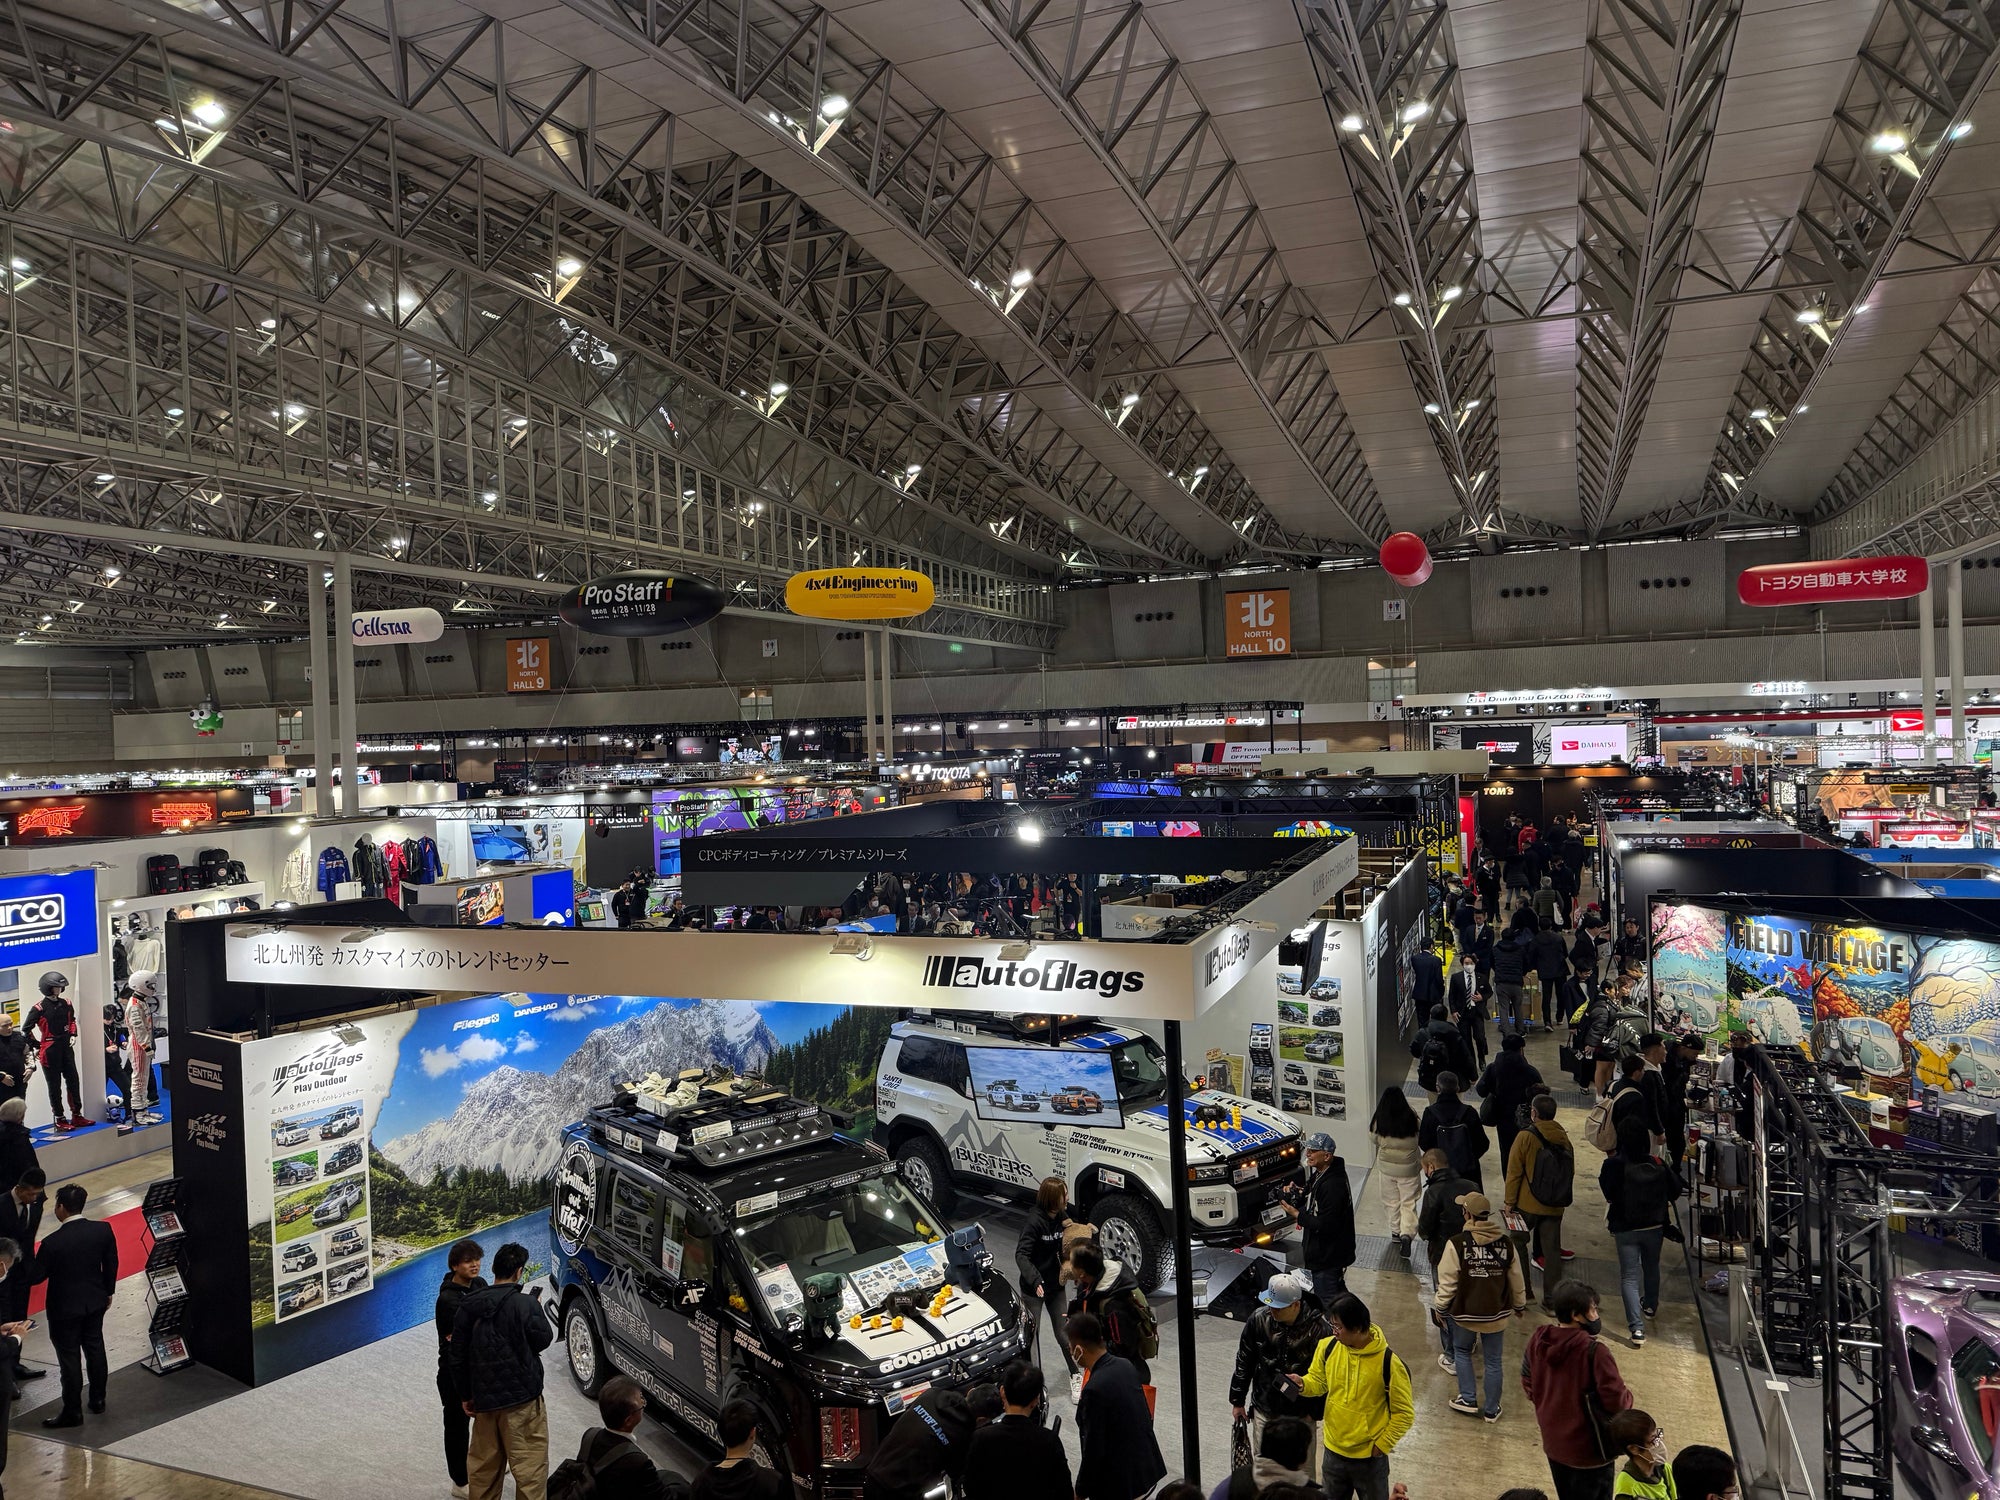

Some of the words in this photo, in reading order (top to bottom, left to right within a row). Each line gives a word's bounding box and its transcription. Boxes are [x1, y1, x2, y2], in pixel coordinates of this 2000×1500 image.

[805, 575, 918, 593] 4x4Engineering
[1760, 568, 1908, 592] トヨタ自動車大学校
[1241, 593, 1275, 628] 北
[1244, 630, 1272, 638] NORTH
[517, 640, 540, 669] 北
[1231, 644, 1262, 654] HALL
[1267, 637, 1286, 652] 10
[513, 680, 535, 690] HALL
[536, 676, 545, 690] 9
[1140, 719, 1184, 728] TOYOTA
[1185, 718, 1225, 727] GAZOO
[1226, 716, 1265, 727] Racing
[281, 745, 287, 754] 9
[931, 766, 970, 781] TOYOTA
[1483, 786, 1515, 796] TOM'S
[4, 934, 60, 947] PERFORMANCE
[1733, 922, 1793, 957] FIELD
[1799, 931, 1904, 974] VILLAGE
[253, 943, 323, 966] 北九州発
[331, 946, 569, 972] カスタマイズのトレンドセッター
[953, 956, 1145, 998] autoflags
[188, 1066, 223, 1083] CENTRAL
[882, 1074, 903, 1085] SANTA
[294, 1084, 313, 1094] Play
[314, 1075, 348, 1090] Outdoor
[883, 1081, 900, 1090] CRUZ
[1069, 1136, 1088, 1147] OPEN
[1089, 1141, 1122, 1155] COUNTRY
[1123, 1148, 1137, 1159] R/T
[1232, 1129, 1279, 1150] autoflags
[955, 1145, 1034, 1178] BUSTERS
[969, 1163, 996, 1179] HAVE
[562, 1167, 591, 1201] Chilling
[568, 1193, 581, 1210] out
[560, 1205, 586, 1235] life!
[600, 1292, 652, 1342] BUSTERS
[733, 1336, 748, 1350] OPEN
[746, 1342, 773, 1363] COUNTRY
[913, 1404, 950, 1447] AUTOFLAGS
